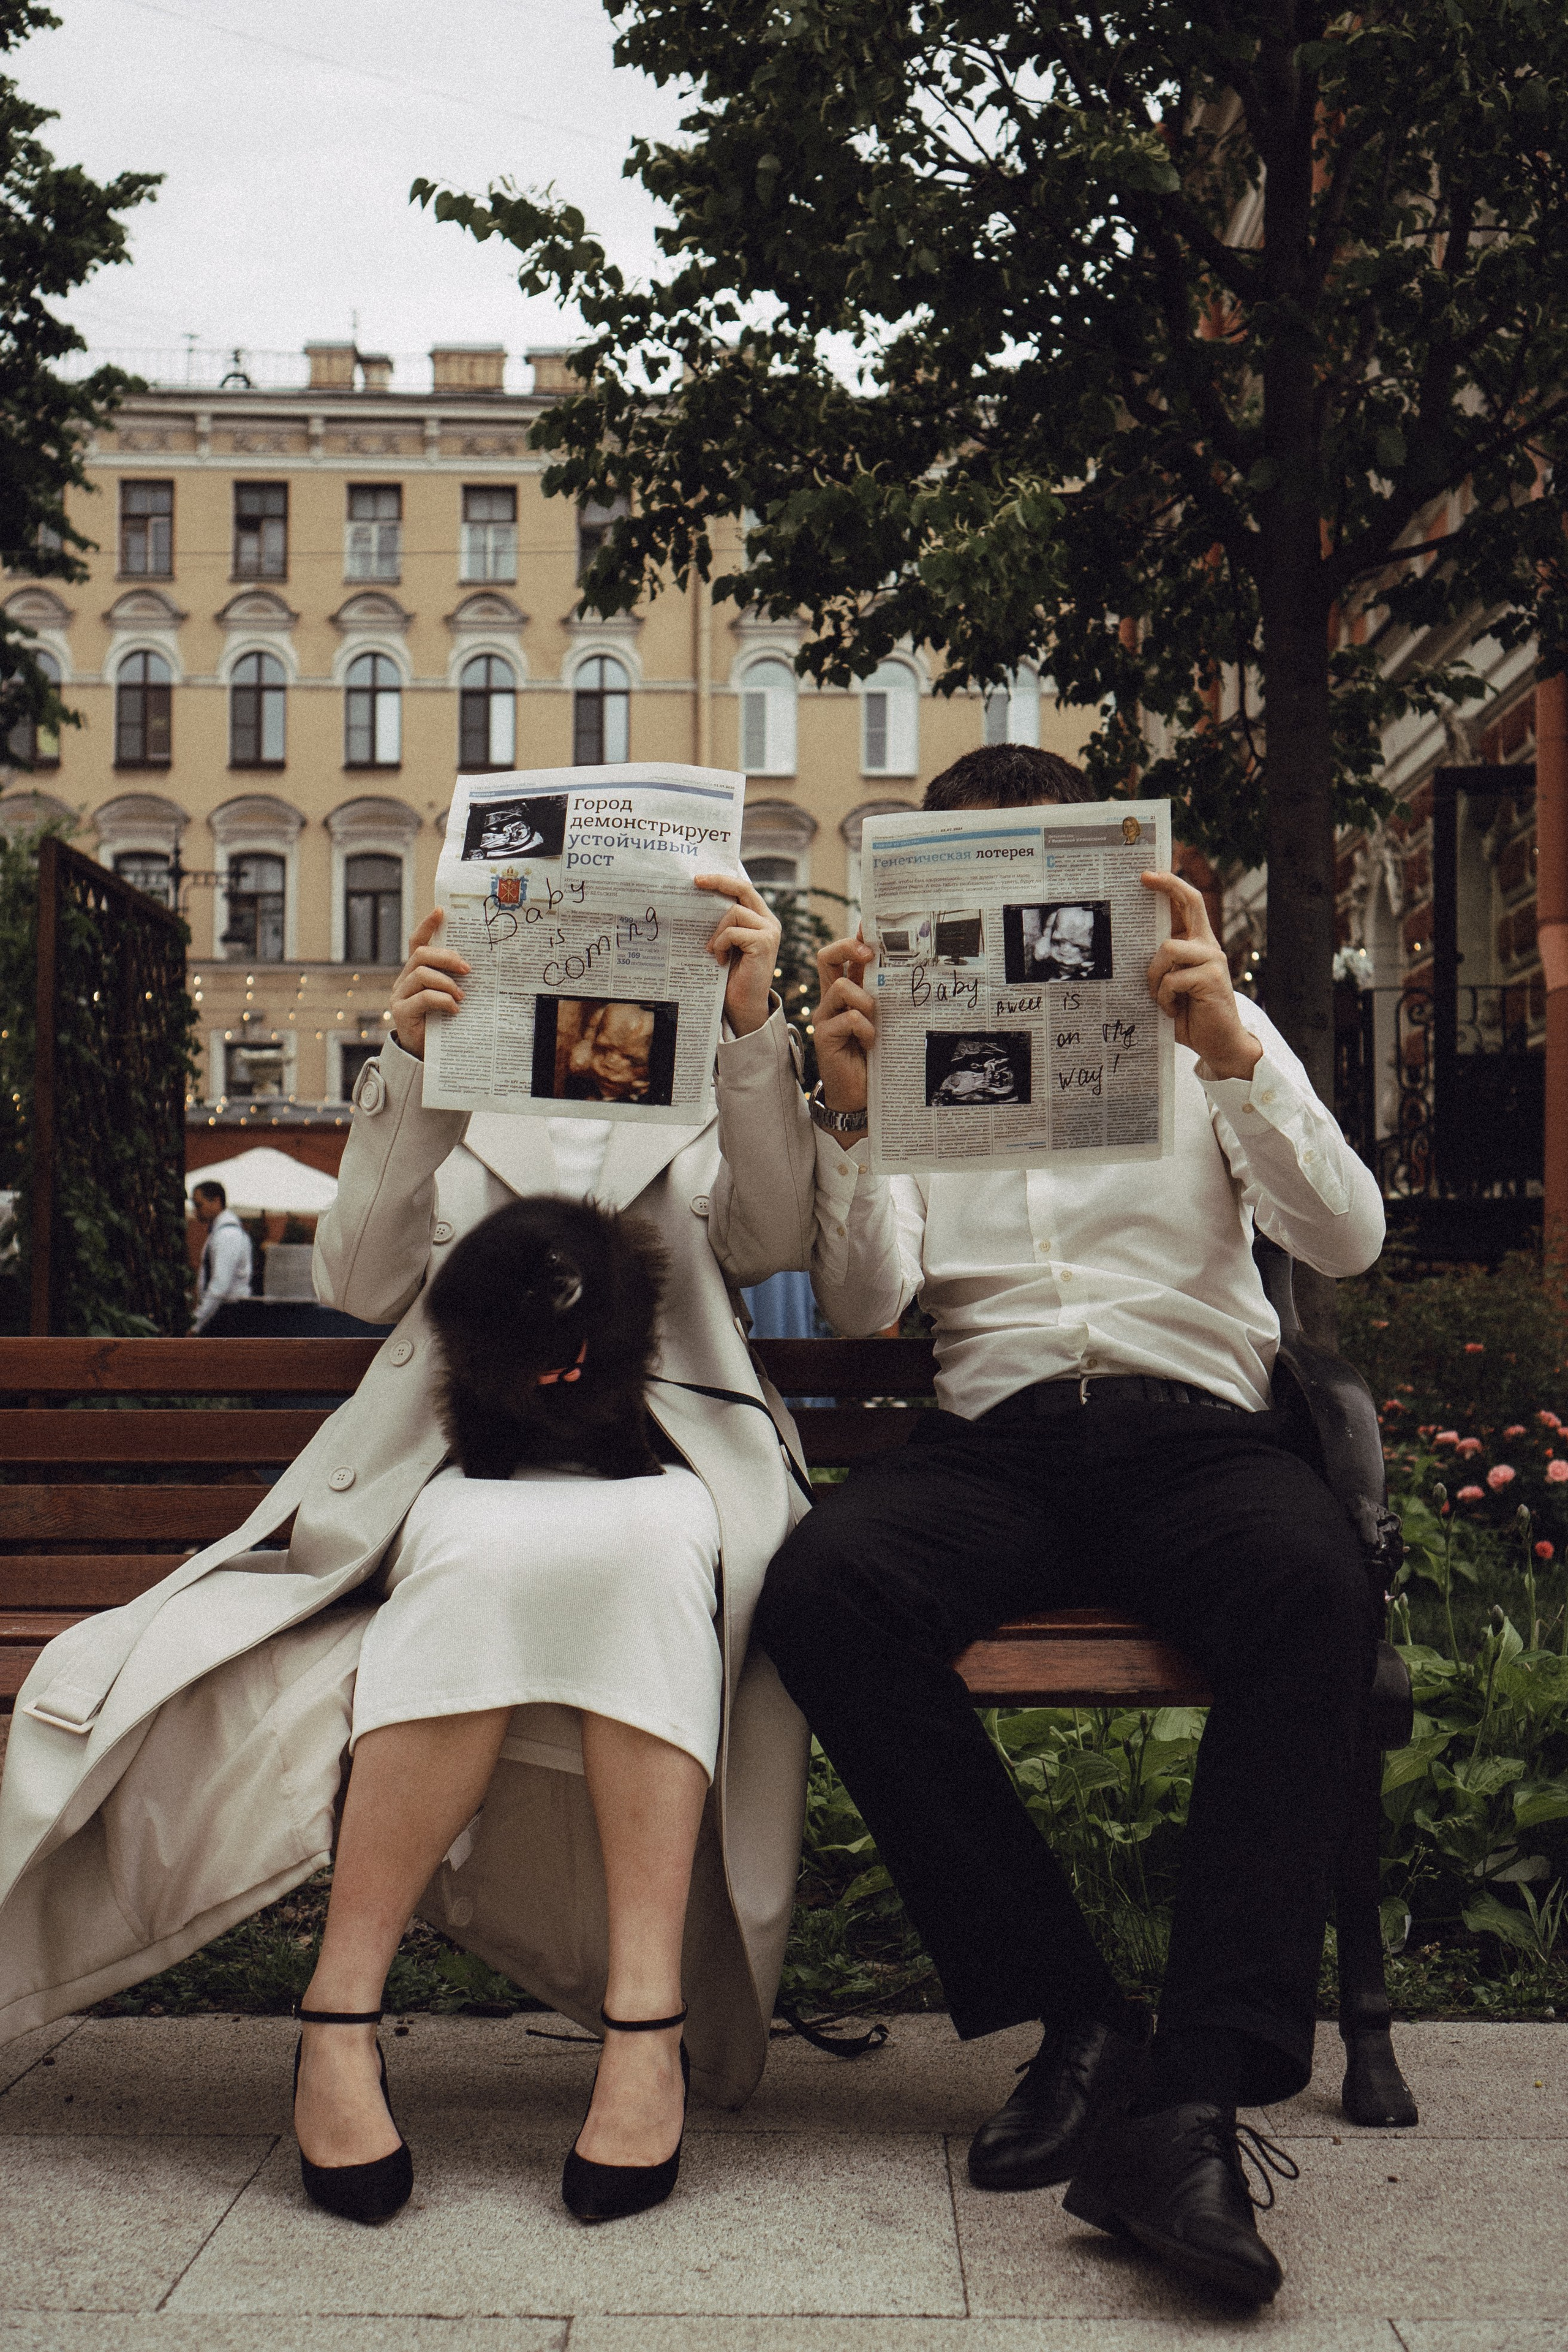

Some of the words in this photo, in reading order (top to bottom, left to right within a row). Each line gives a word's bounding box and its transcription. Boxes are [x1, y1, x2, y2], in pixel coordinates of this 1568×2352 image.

[573, 798, 633, 813] Город
[570, 816, 731, 844] демонстрирует
[568, 833, 698, 856] устойчивый
[567, 853, 614, 869] рост
[873, 850, 971, 869] Генетическая
[976, 848, 1035, 861] лотерея
[483, 877, 585, 951] Baby
[543, 907, 658, 986] coming
[548, 928, 565, 948] is
[911, 965, 979, 1009] Baby
[1063, 992, 1080, 1011] is
[1057, 1031, 1080, 1047] on
